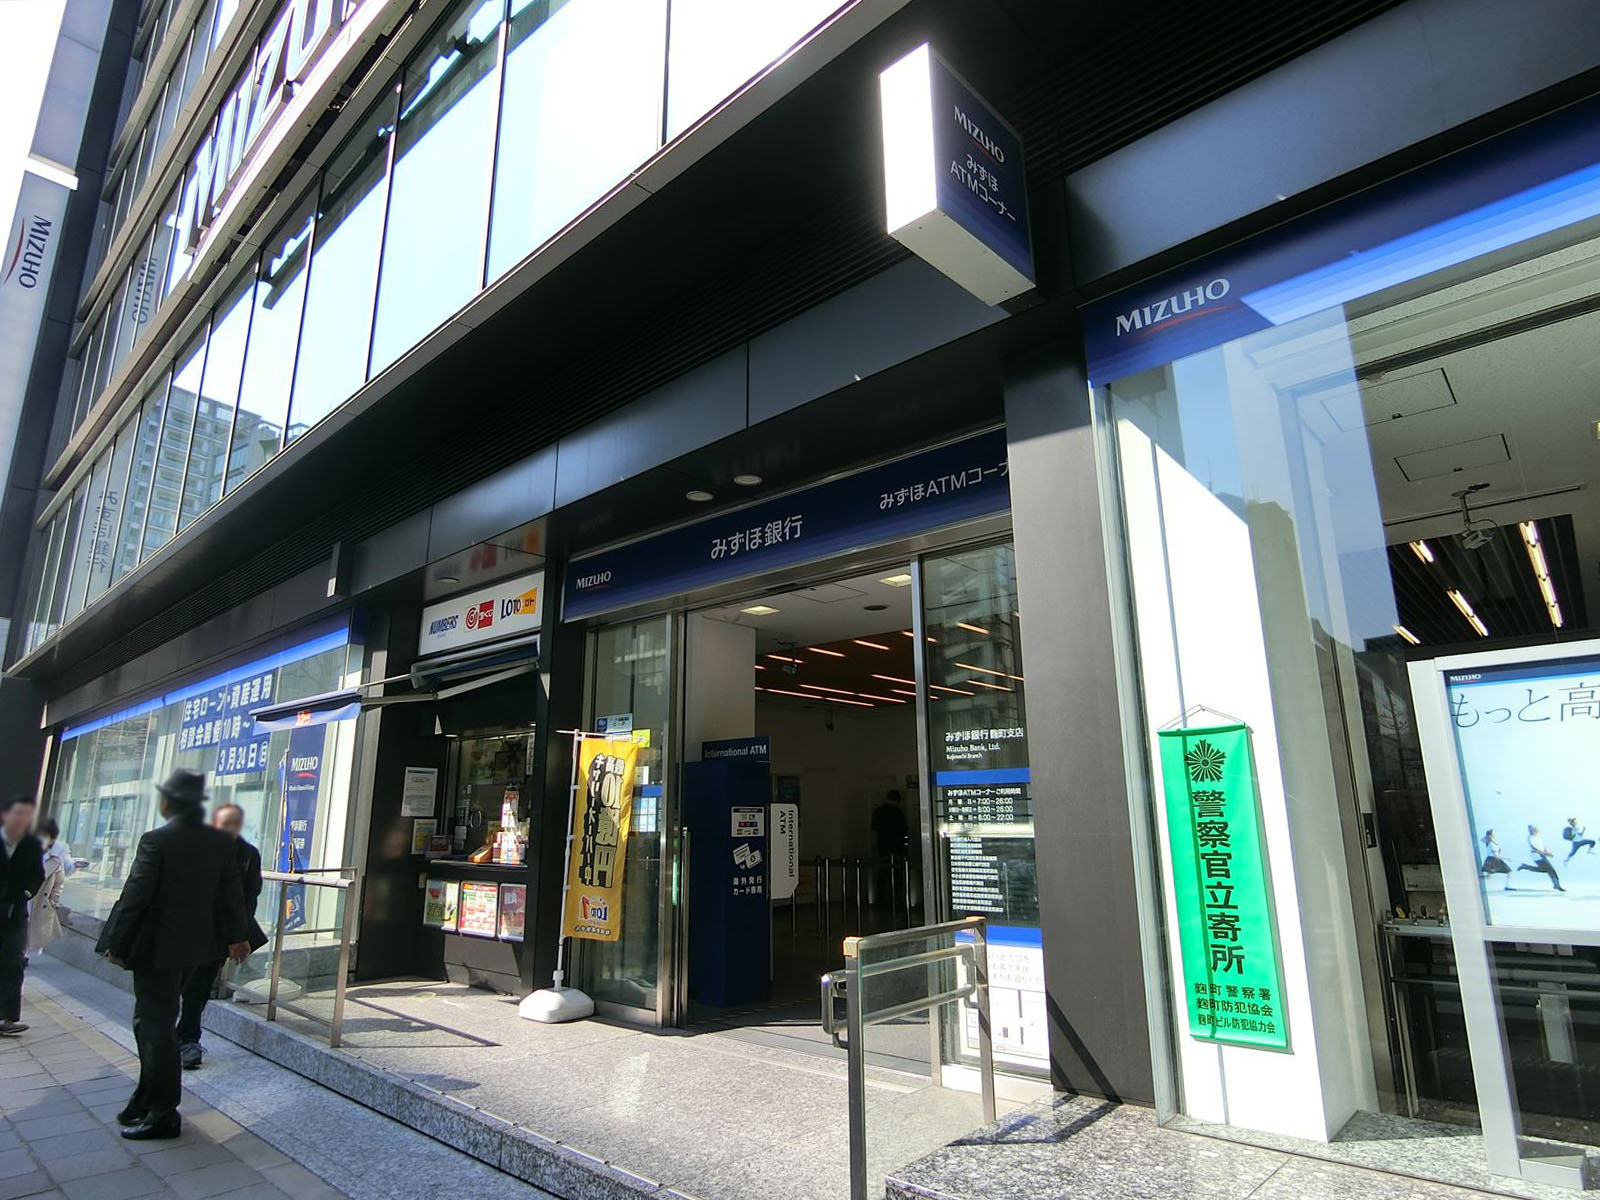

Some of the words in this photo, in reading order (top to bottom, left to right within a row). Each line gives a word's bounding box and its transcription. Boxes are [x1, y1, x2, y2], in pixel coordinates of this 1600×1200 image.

[954, 105, 1005, 163] MIZUHO
[967, 154, 999, 193] みずほ
[950, 160, 1016, 222] ATMコーナー
[19, 214, 52, 288] MIZUHO
[1115, 278, 1231, 337] MIZUHO
[711, 514, 803, 559] みずほ銀行
[576, 570, 612, 590] MIZUHO
[500, 598, 522, 620] LOTO
[429, 615, 459, 636] NUMBERS
[1450, 673, 1482, 682] MIZUHO
[945, 729, 989, 742] みずほ銀行
[704, 747, 748, 758] International
[750, 745, 767, 755] ATM
[946, 745, 969, 753] Mizuho
[970, 743, 987, 752] Bank,
[291, 756, 319, 772] MIZUHO
[733, 876, 762, 886] 海外発行
[1191, 789, 1245, 975] 警察官立寄所
